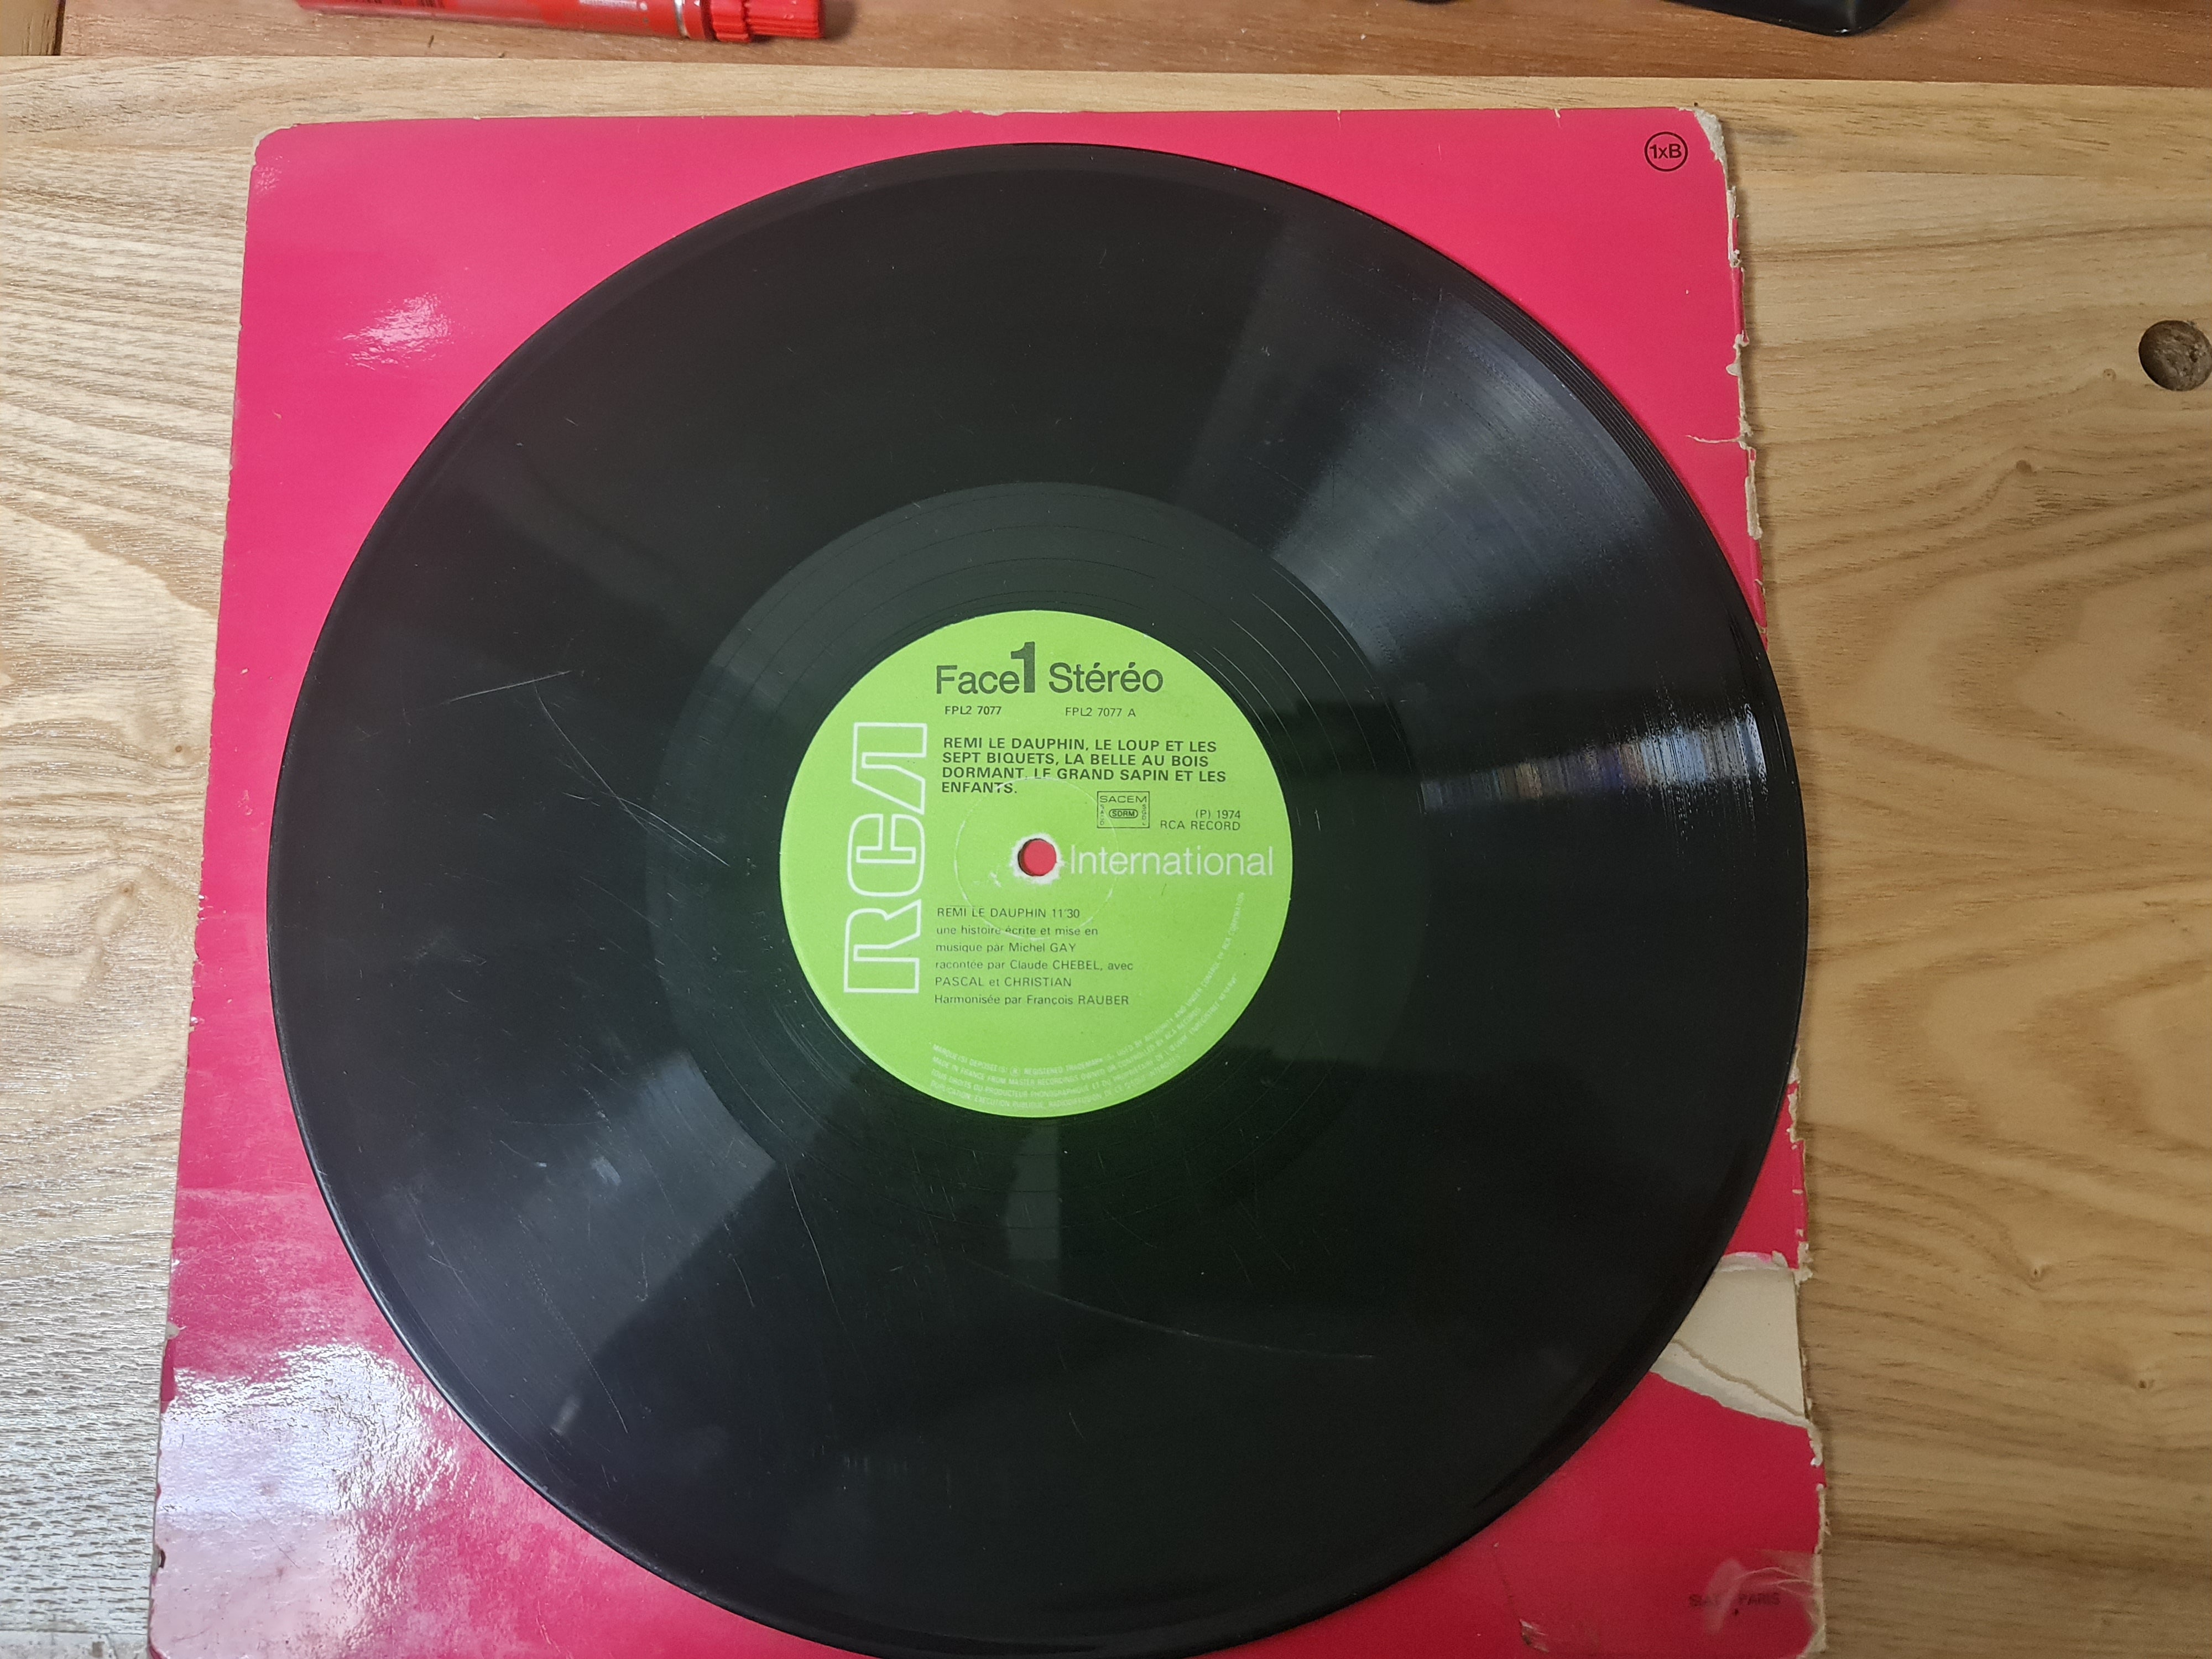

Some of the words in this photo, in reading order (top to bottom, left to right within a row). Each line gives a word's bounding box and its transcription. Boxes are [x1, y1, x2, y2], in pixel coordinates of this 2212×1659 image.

[1650, 144, 1682, 159] 1xB
[1049, 662, 1163, 693] Stéréo
[945, 706, 972, 714] FPL2
[977, 706, 1001, 715] 7077
[1066, 707, 1092, 716] FPL2
[1098, 708, 1122, 717] 7077
[1128, 708, 1136, 717] A
[944, 738, 982, 748] REMI
[989, 738, 1005, 748] LE
[1012, 738, 1088, 750] DAUPHIN,
[1095, 739, 1111, 750] LE
[1118, 740, 1159, 751] LOUP
[1166, 740, 1183, 752] ET
[1190, 742, 1216, 752] LES
[943, 752, 980, 763] SEPT
[987, 753, 1058, 765] BIQUETS,
[1065, 754, 1084, 764] LA
[1091, 754, 1135, 765] BELLE
[1142, 755, 1164, 766] AU
[1172, 755, 1208, 767] BOIS
[1057, 768, 1114, 780] GRAND
[1120, 769, 1168, 781] SAPIN
[1176, 770, 1193, 781] ET
[1199, 771, 1225, 782] LES
[942, 782, 1017, 794] ENFANTS.
[1217, 810, 1240, 819] 1974
[1160, 820, 1185, 830] RCA
[1191, 821, 1240, 831] RECORD
[844, 722, 927, 993] RCA
[1070, 845, 1273, 875] International
[937, 907, 966, 917] REMI
[972, 908, 984, 917] LE
[990, 908, 1046, 917] DAUPHIN
[961, 925, 1001, 935] histoire
[1005, 926, 1036, 935] écrite
[1055, 926, 1080, 936] mise
[936, 945, 982, 953] musique
[987, 945, 1004, 953] par
[1009, 942, 1045, 952] Michel
[1050, 943, 1076, 952] GAY
[1010, 959, 1047, 969] Claude
[1053, 960, 1103, 971] CHEBEL,
[936, 977, 983, 986] PASCAL
[1004, 977, 1071, 987] CHRISTIAN
[935, 995, 1000, 1004] Harmonisée
[1027, 995, 1073, 1005] François
[1078, 995, 1129, 1005] RAUBER
